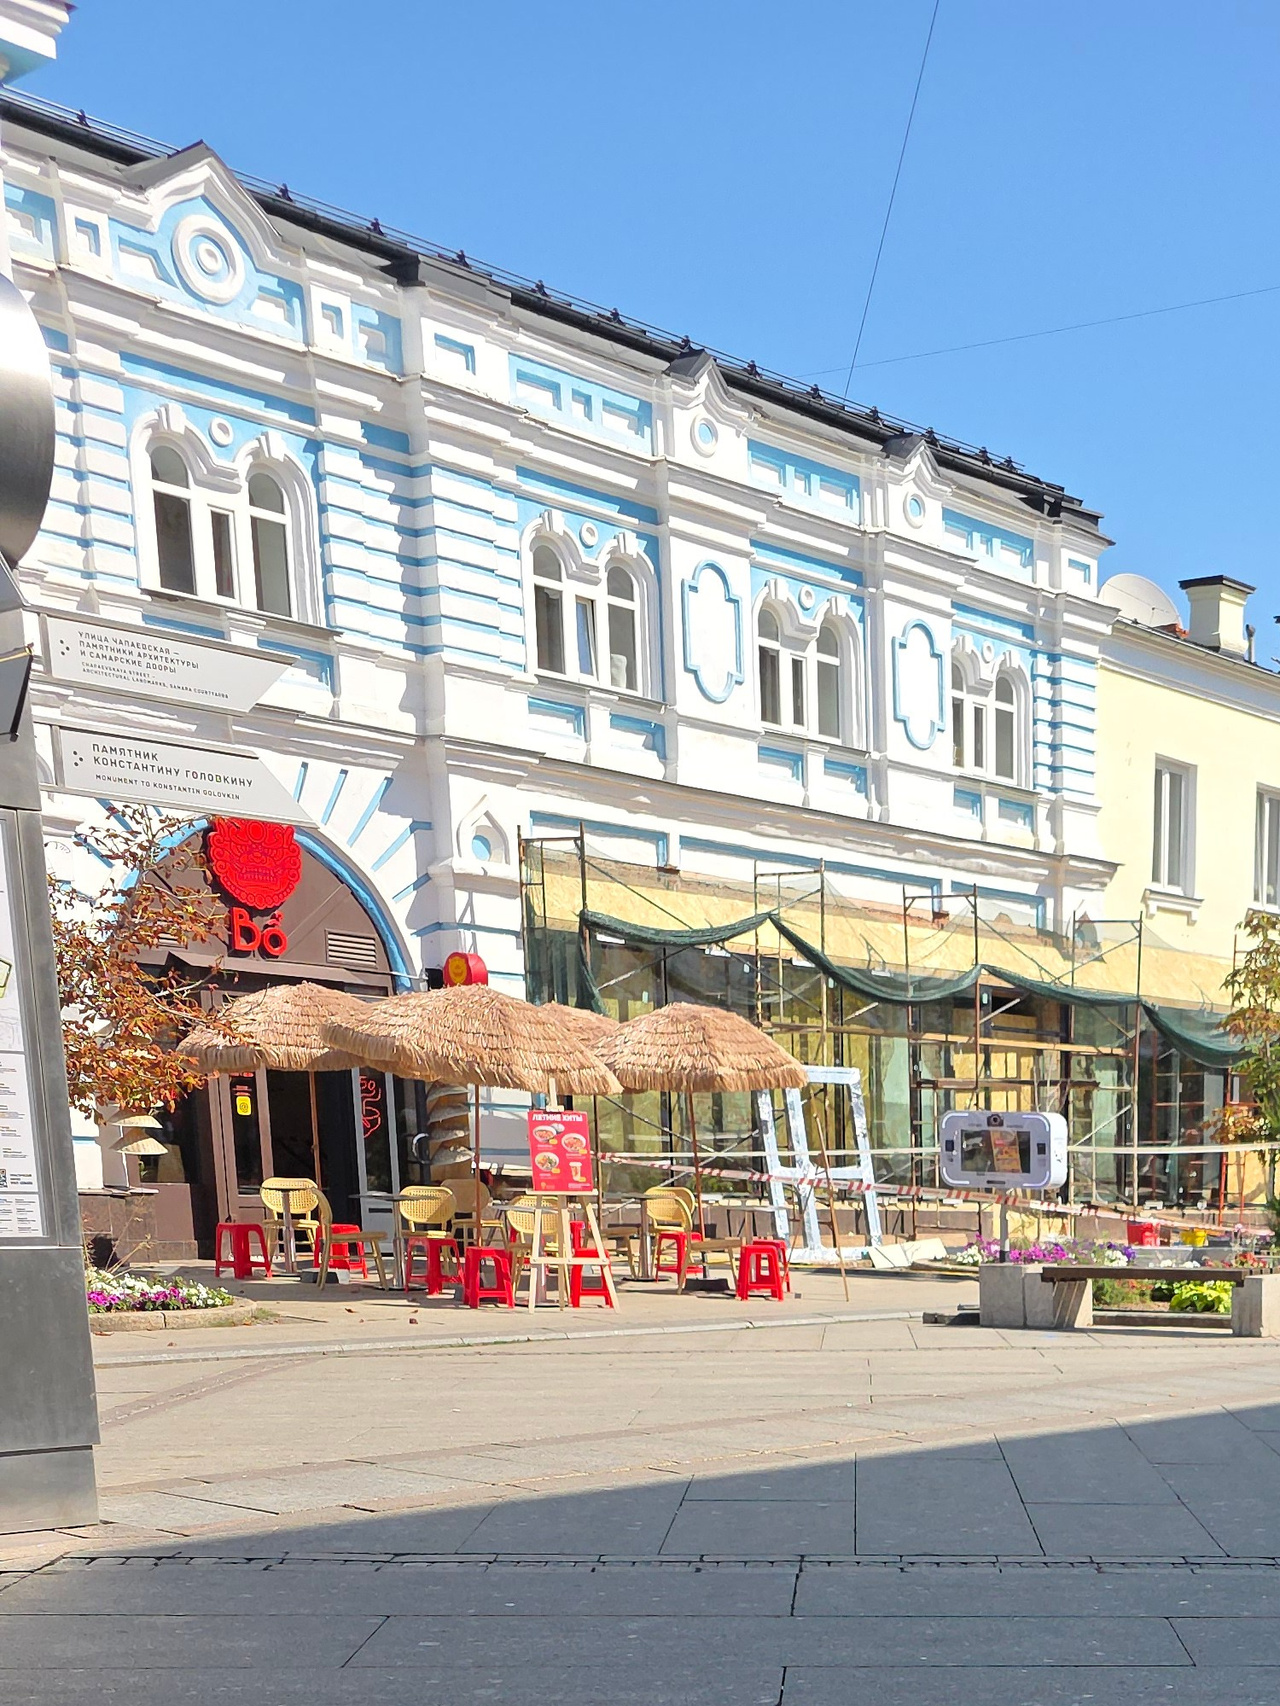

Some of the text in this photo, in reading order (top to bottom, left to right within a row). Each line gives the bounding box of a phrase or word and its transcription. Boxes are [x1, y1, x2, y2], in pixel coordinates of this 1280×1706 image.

[78, 631, 110, 643] УЛИЦА
[112, 637, 170, 655] ЧАПАЕВСКАЯ
[79, 641, 199, 669] ПАМЯТНИКИ АРХИТЕКТУРЫ
[89, 652, 142, 668] САМАРСКИЕ
[92, 743, 159, 762] ПАМЯТНИК
[93, 756, 253, 788] КОНСТАНТИНУ ГОЛОВКИНУ
[95, 774, 139, 786] MONUMENT
[153, 782, 201, 795] KONSTANTIN
[203, 790, 240, 800] GOLOVKIN
